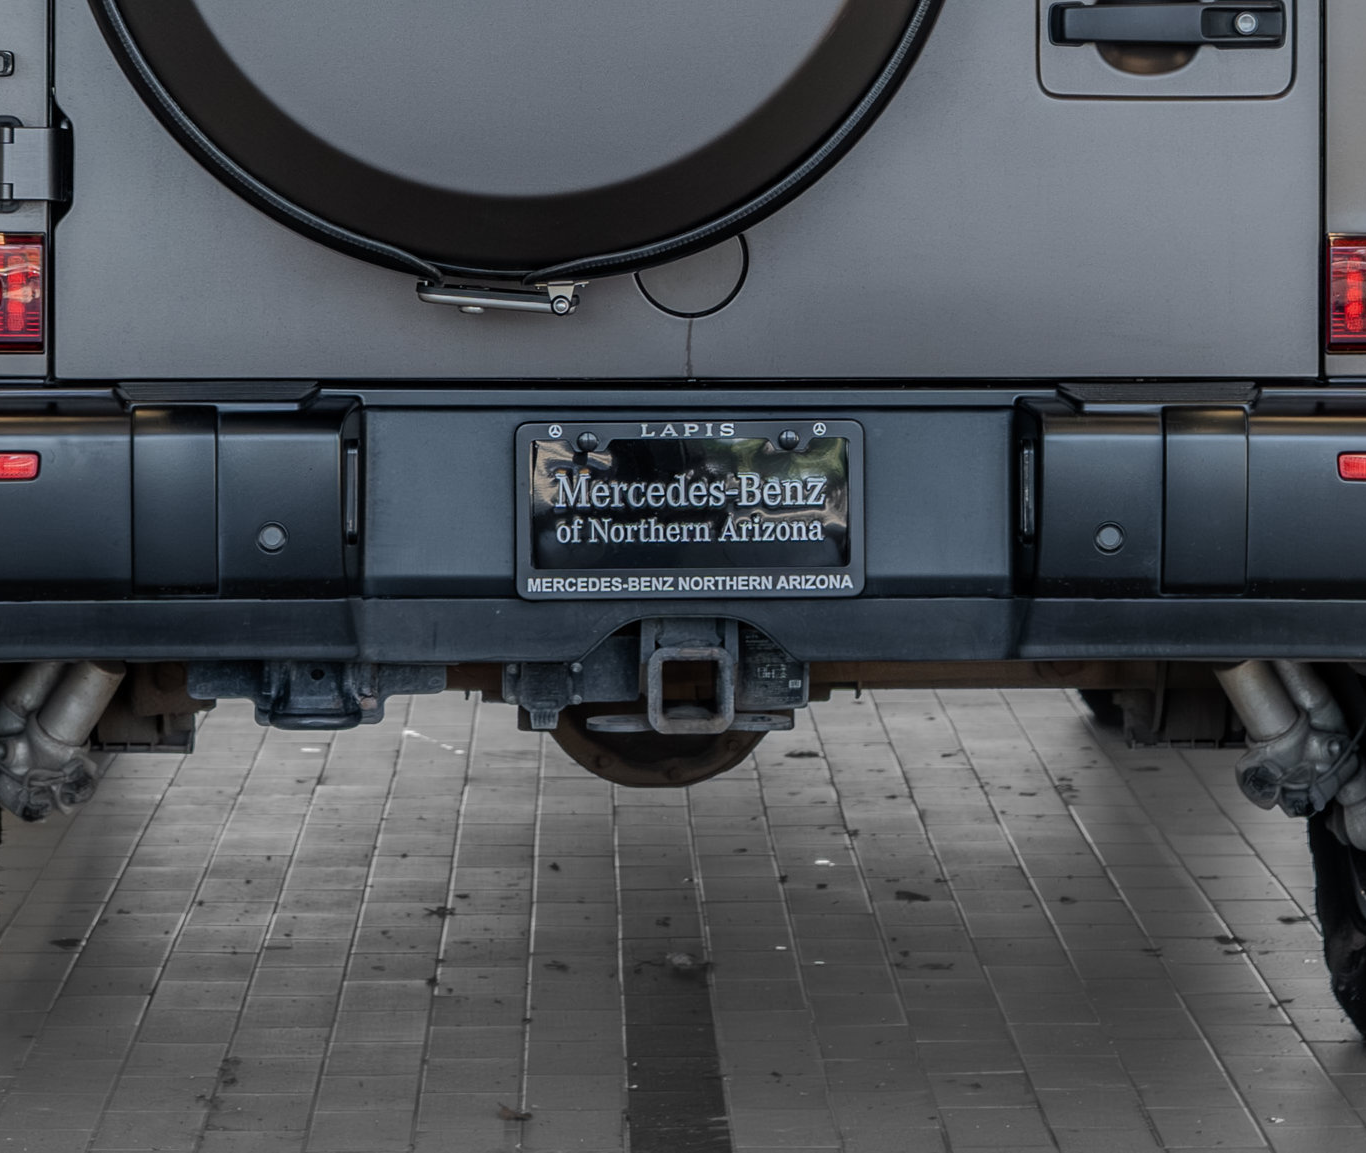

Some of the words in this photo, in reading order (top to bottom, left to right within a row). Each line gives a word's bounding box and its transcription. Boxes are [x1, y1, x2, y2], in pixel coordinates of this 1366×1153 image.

[640, 423, 735, 437] LAPIS
[554, 472, 827, 509] Mercedes-Benz
[556, 521, 583, 544] of
[588, 518, 711, 543] Northern
[718, 515, 824, 542] Arizona
[527, 577, 674, 592] MERCEDES-BENZ
[678, 575, 773, 590] NORTHERN
[776, 574, 853, 590] ARIZONA
